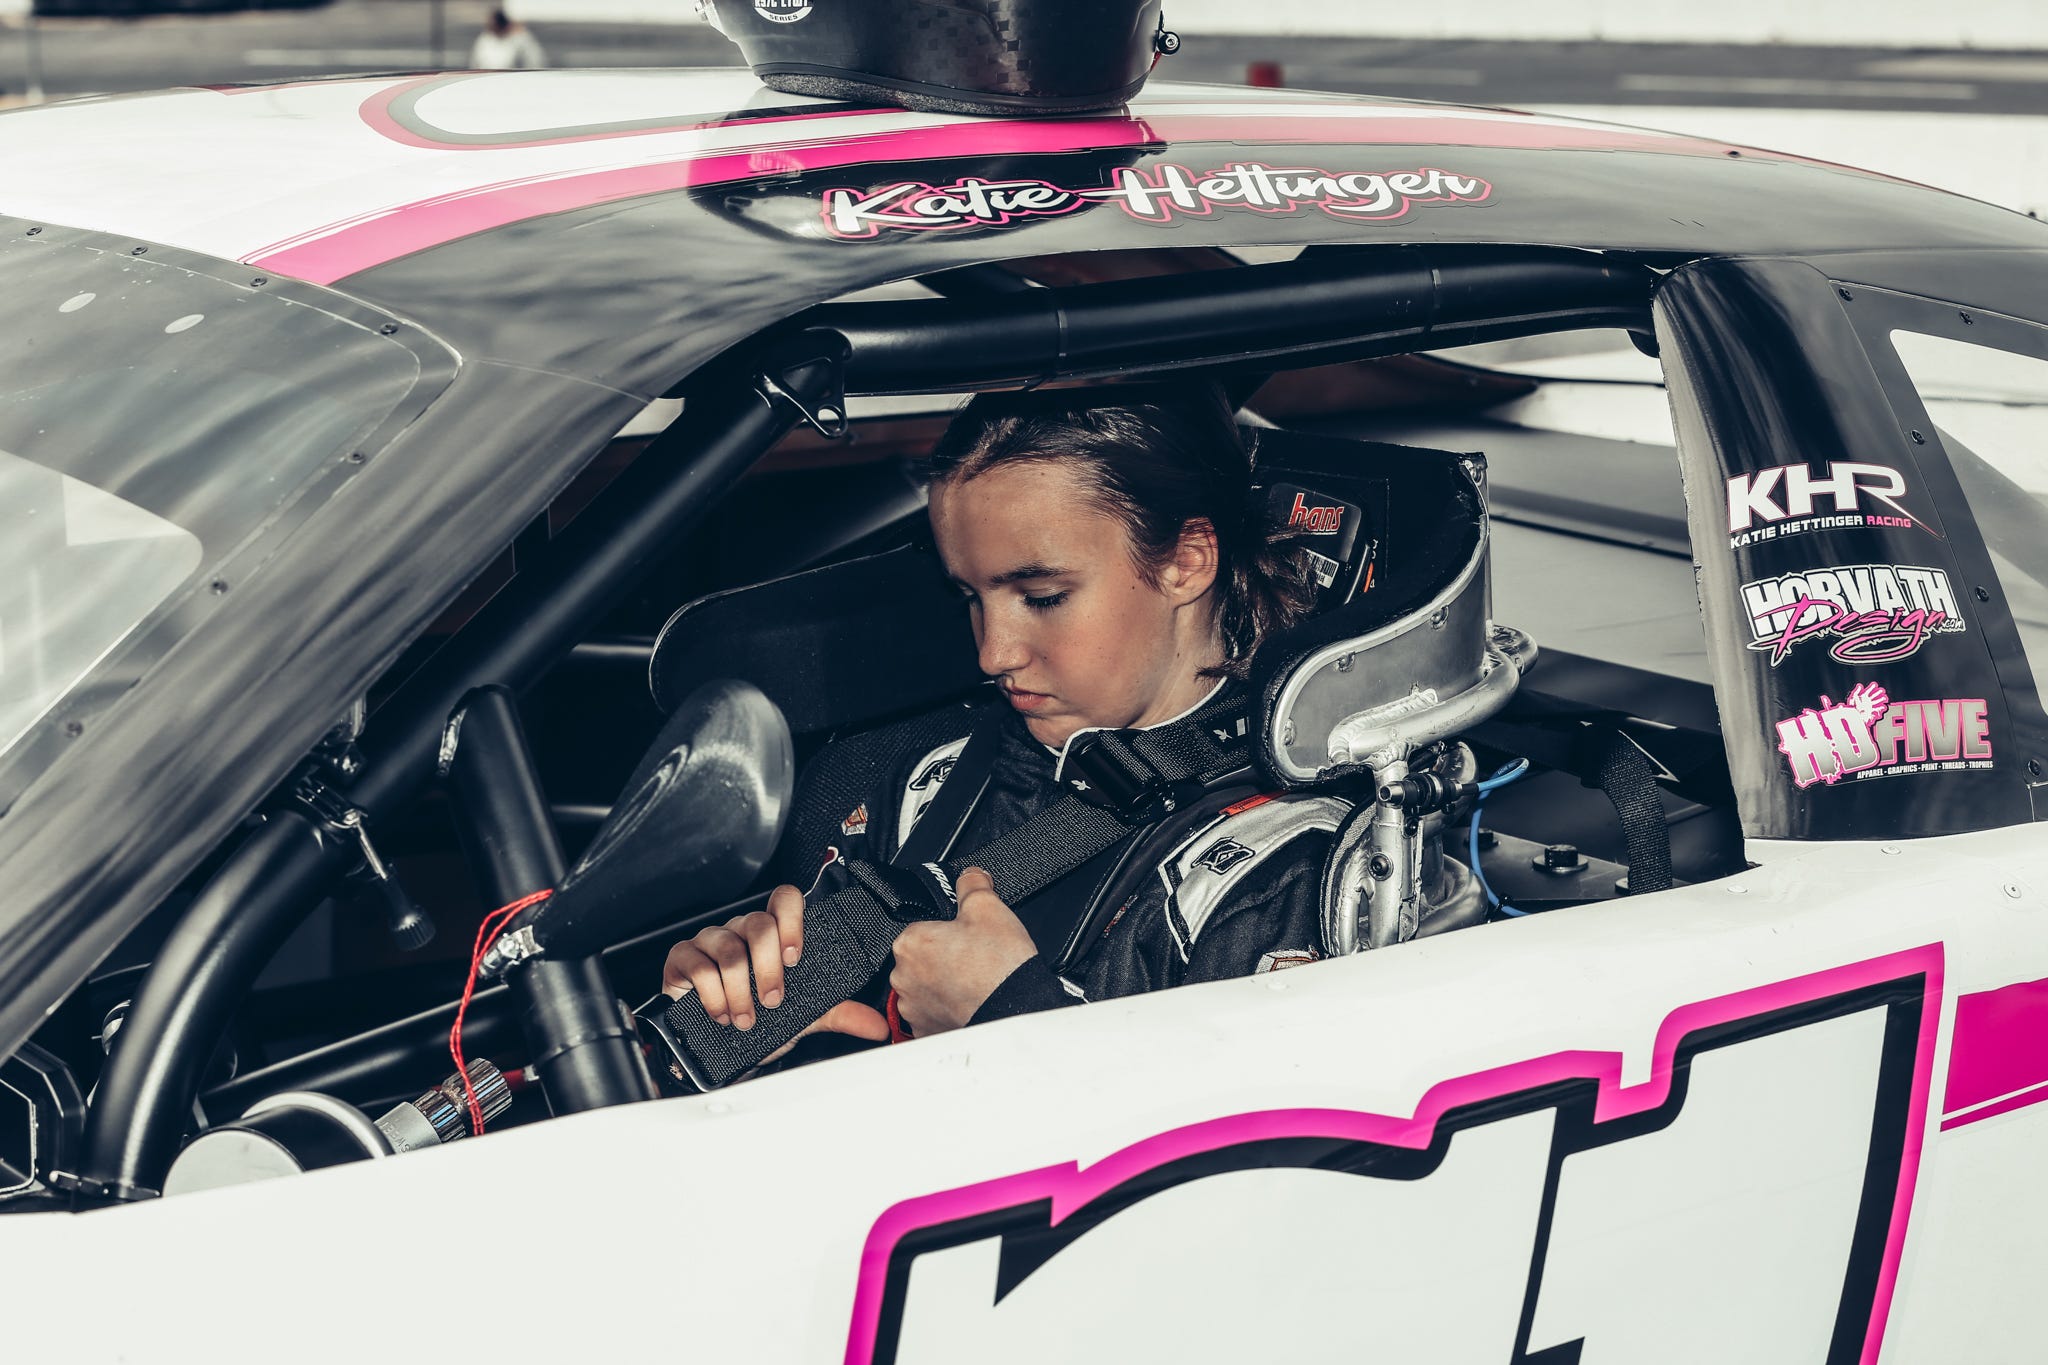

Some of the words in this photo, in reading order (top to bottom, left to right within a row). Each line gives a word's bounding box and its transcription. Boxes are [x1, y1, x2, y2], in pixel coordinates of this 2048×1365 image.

[830, 180, 1070, 232] Katie
[1079, 164, 1478, 215] Hettinger
[1289, 492, 1344, 532] hans
[1728, 461, 1944, 541] KHR
[1730, 526, 1776, 549] KATIE
[1780, 515, 1863, 536] HETTINGER
[1866, 515, 1912, 528] RACING
[1744, 567, 1960, 637] HORVATH
[1857, 770, 1884, 779] APPAREL
[1887, 764, 1918, 775] GRAPHICS
[1921, 762, 1938, 772] PRINT
[1942, 761, 1966, 770] THREADS
[1969, 760, 1994, 769] TROPHIES
